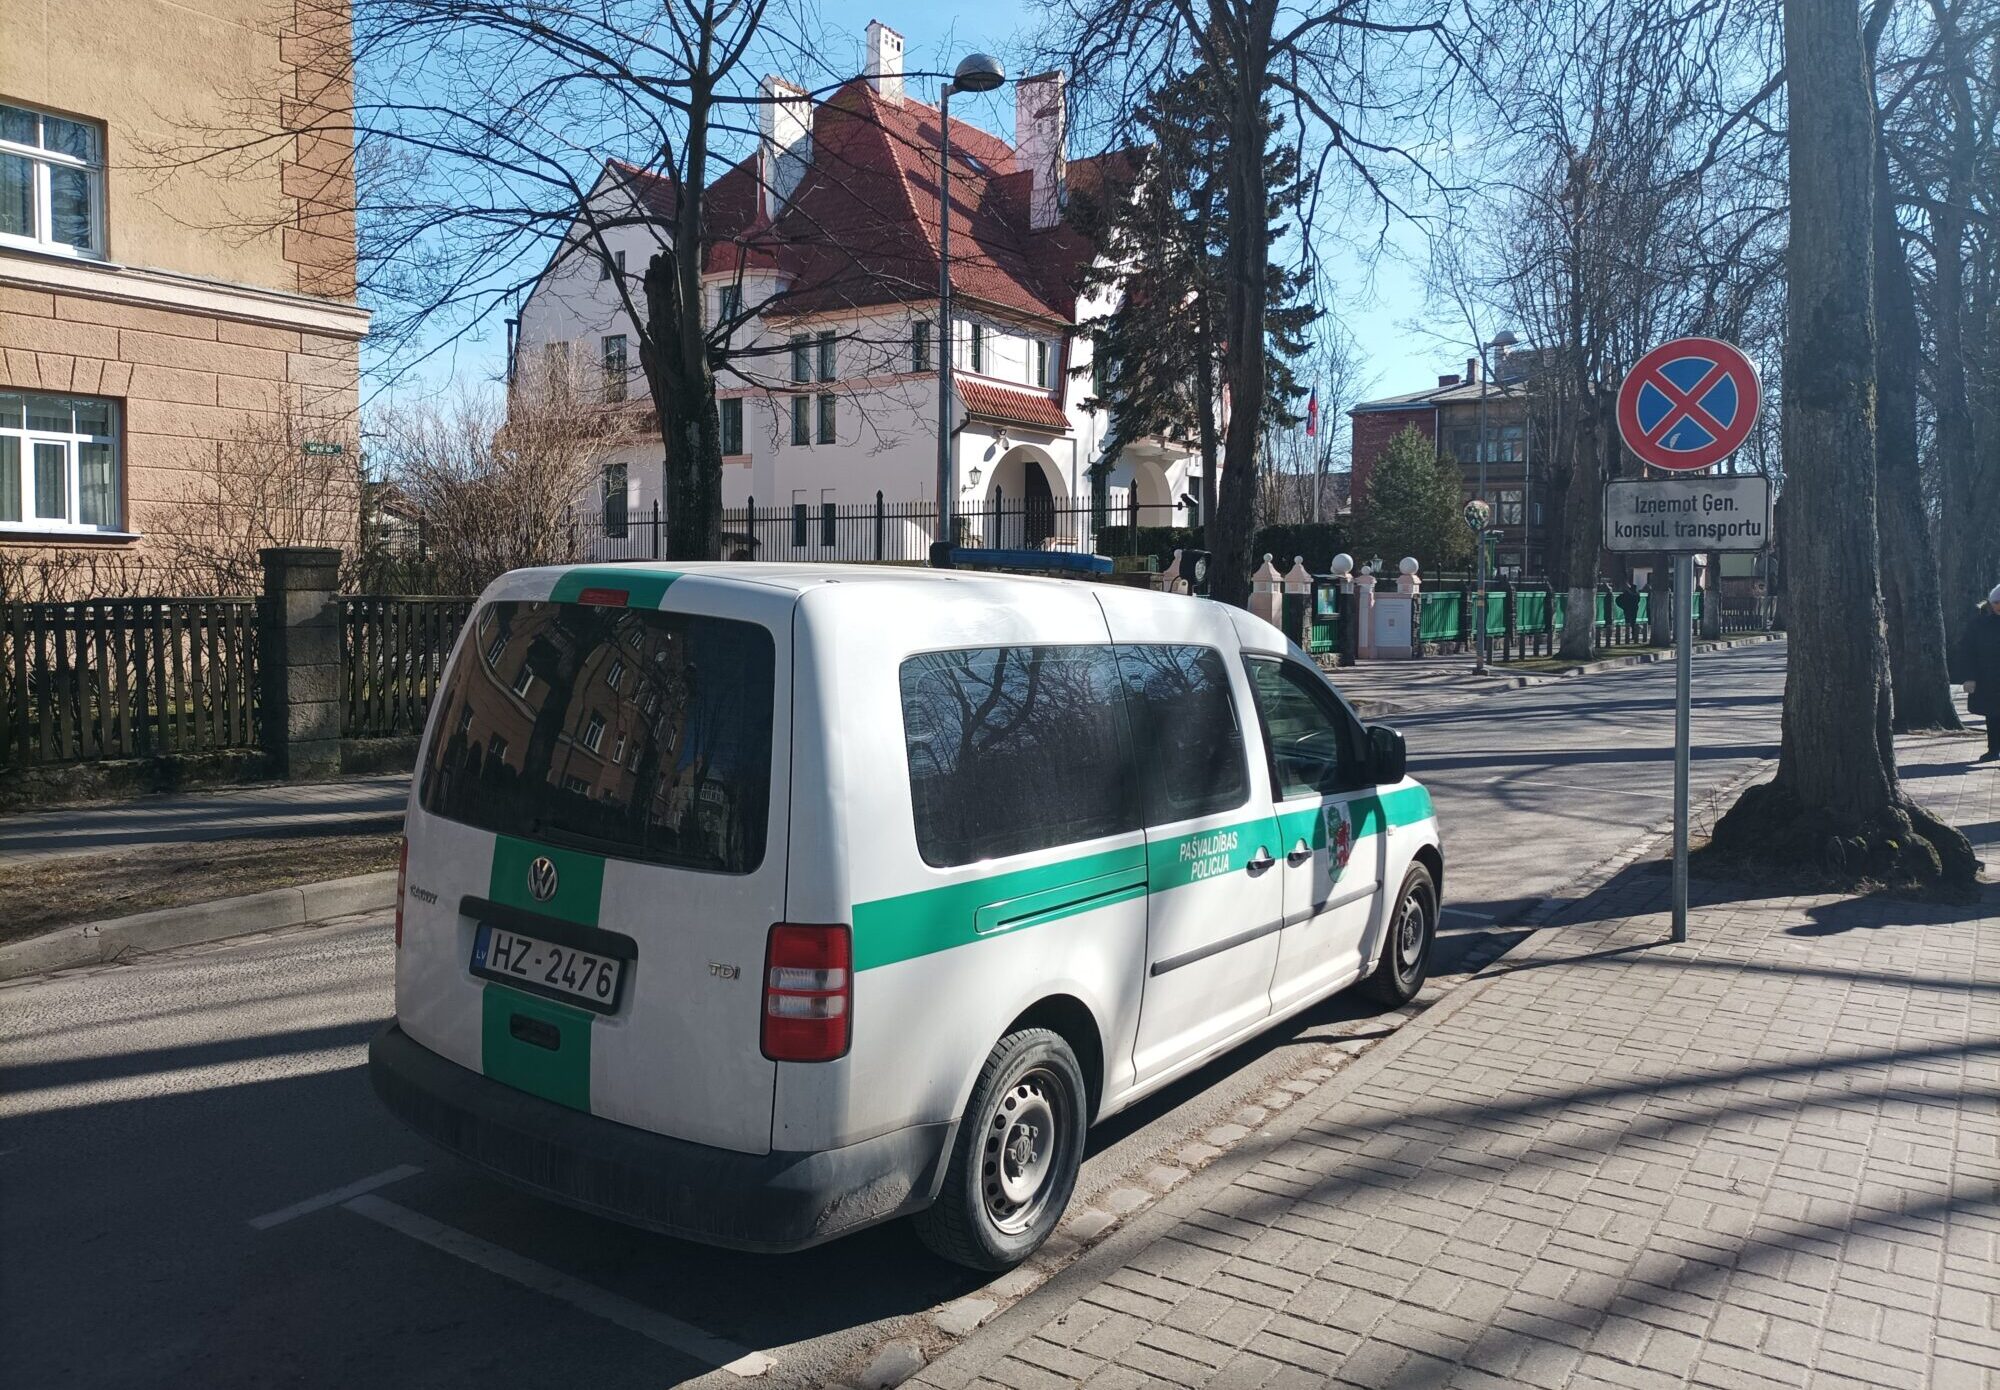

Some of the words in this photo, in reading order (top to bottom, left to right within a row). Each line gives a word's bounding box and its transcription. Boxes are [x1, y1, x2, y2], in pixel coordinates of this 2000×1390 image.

[1703, 493, 1738, 515] Ģen.
[1675, 519, 1761, 541] transportu
[1180, 831, 1238, 861] PAŠVALDĪBAS
[1191, 854, 1229, 880] POLICIJA
[475, 949, 487, 960] LV
[708, 961, 741, 980] TDI
